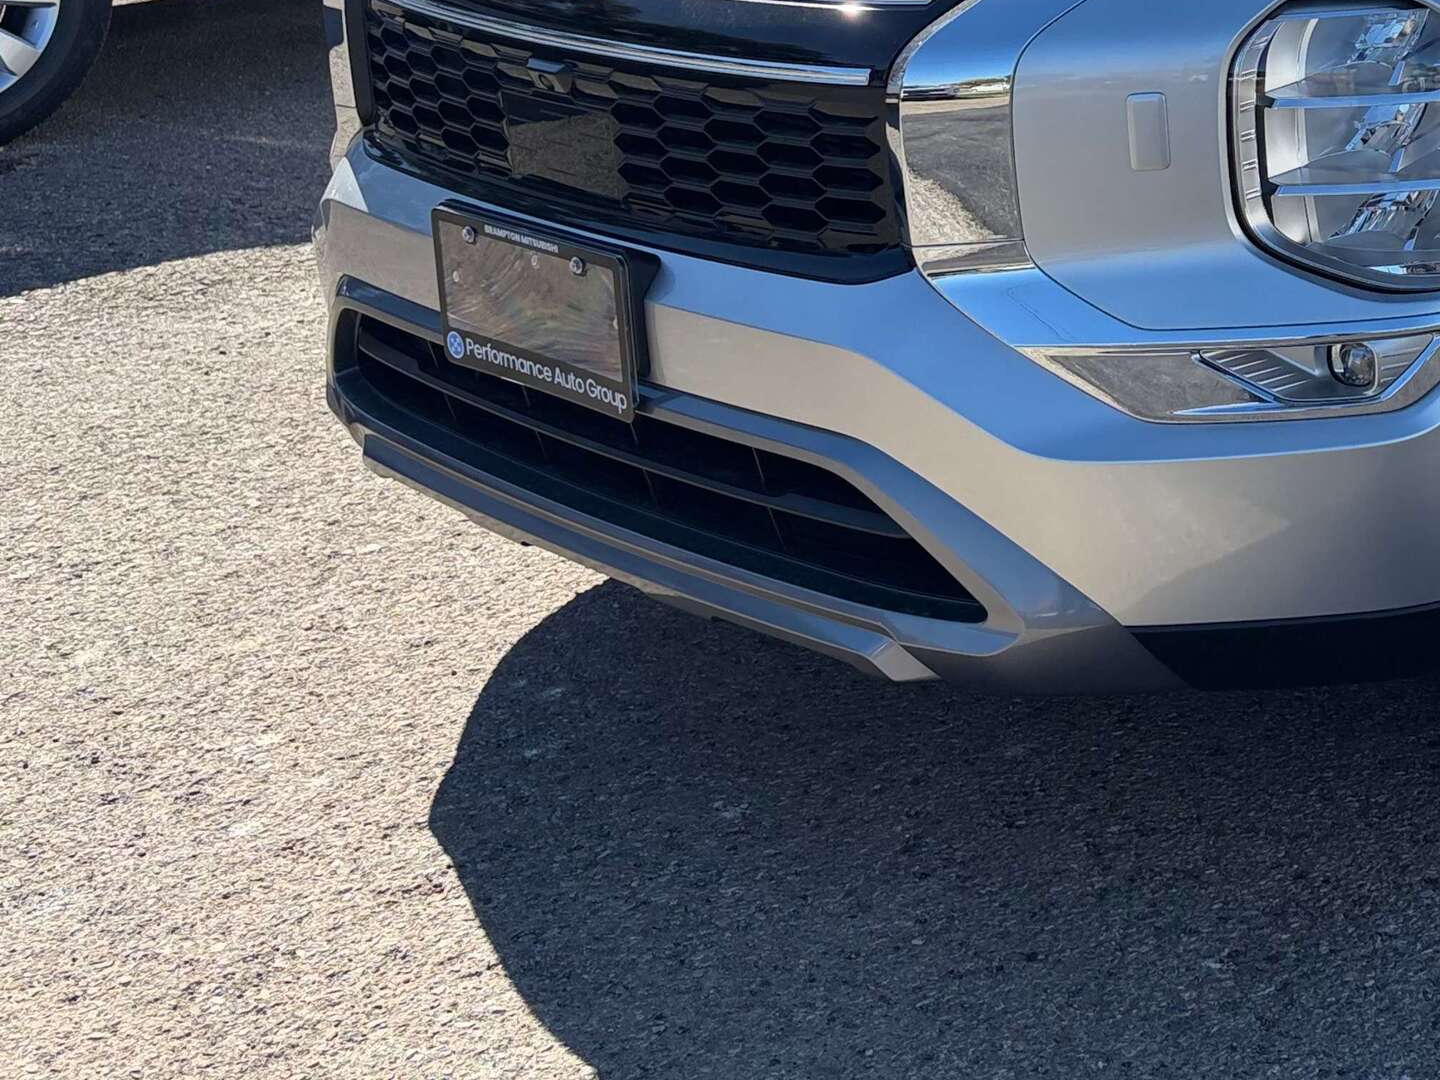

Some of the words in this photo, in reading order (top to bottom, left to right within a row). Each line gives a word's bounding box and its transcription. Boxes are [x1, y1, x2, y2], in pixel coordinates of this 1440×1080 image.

[483, 224, 521, 242] BRAMPTON
[521, 234, 560, 254] MITSUBISHI
[465, 338, 553, 382] Performance
[554, 367, 586, 394] Auto
[586, 378, 628, 414] Group
